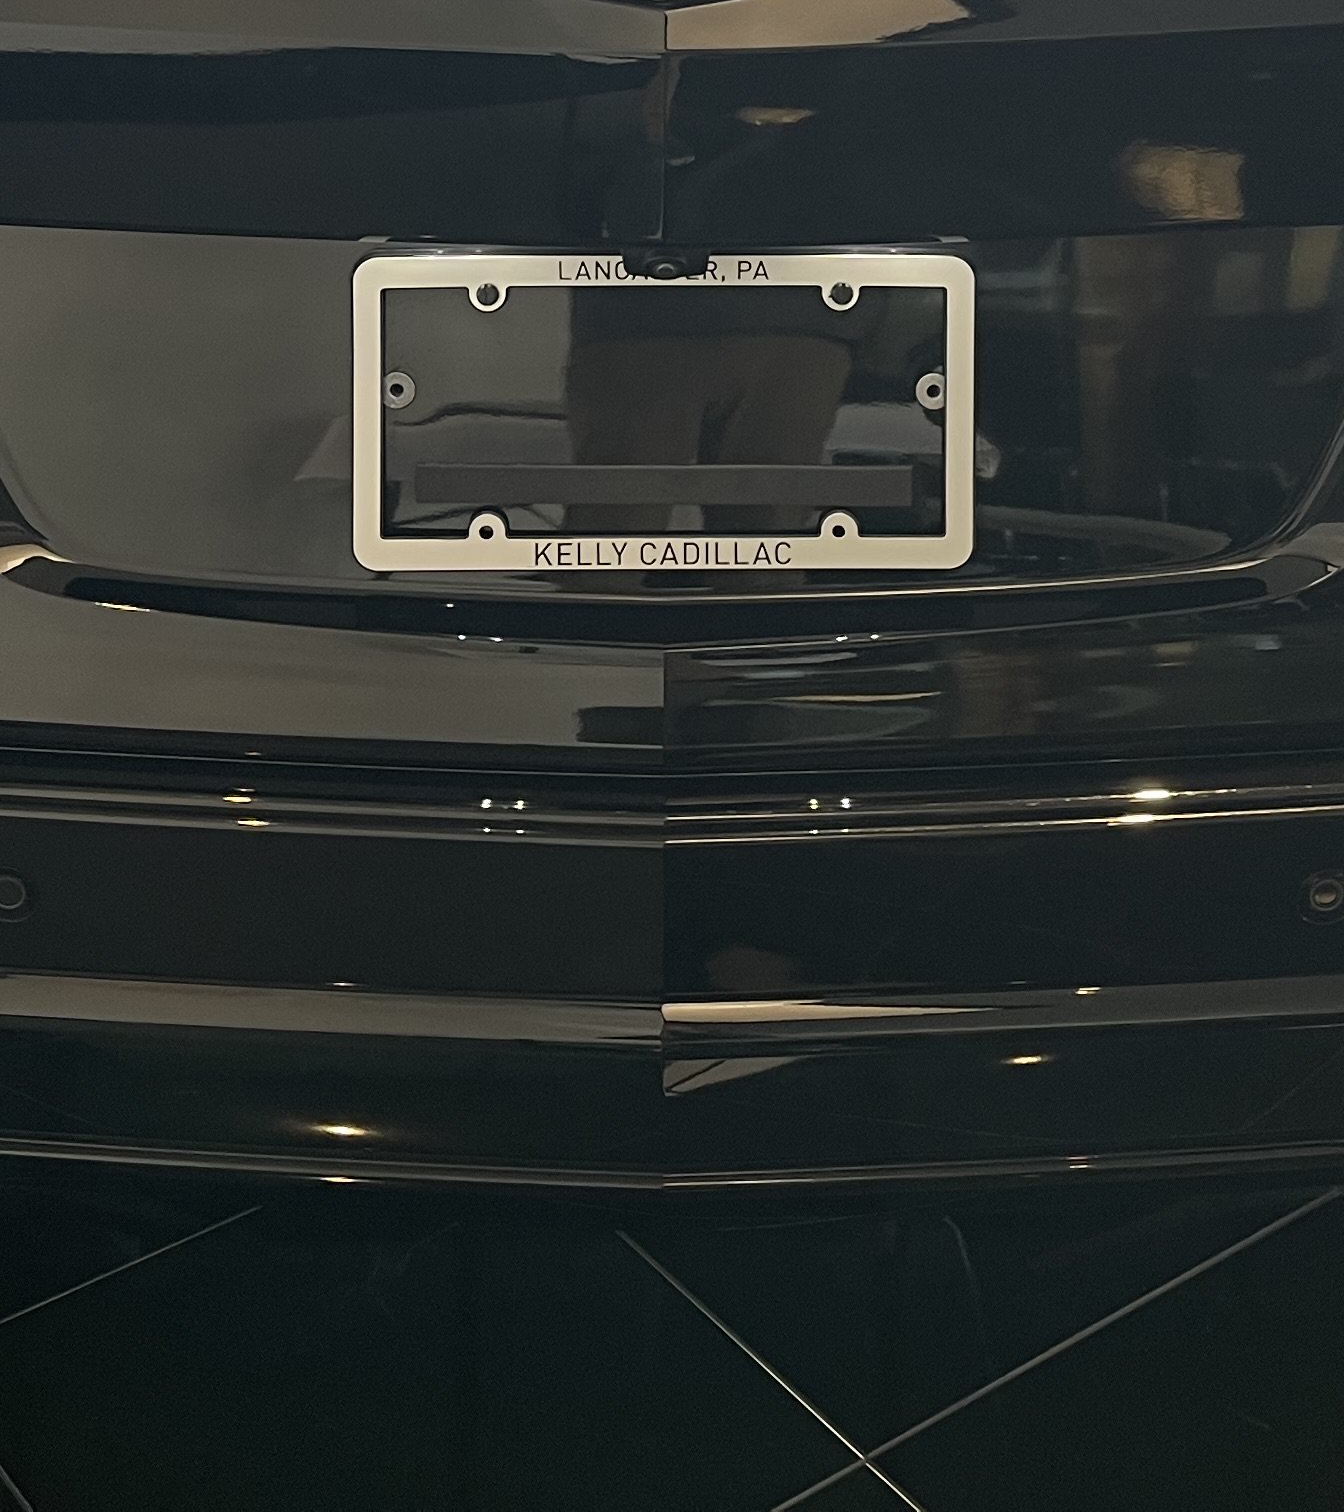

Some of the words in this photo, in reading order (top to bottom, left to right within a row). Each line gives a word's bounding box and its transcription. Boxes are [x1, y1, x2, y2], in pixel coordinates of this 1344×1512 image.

[558, 260, 726, 282] LANCR,
[737, 260, 770, 281] PA
[534, 541, 628, 566] KELLY
[639, 541, 792, 566] CADILLAC
